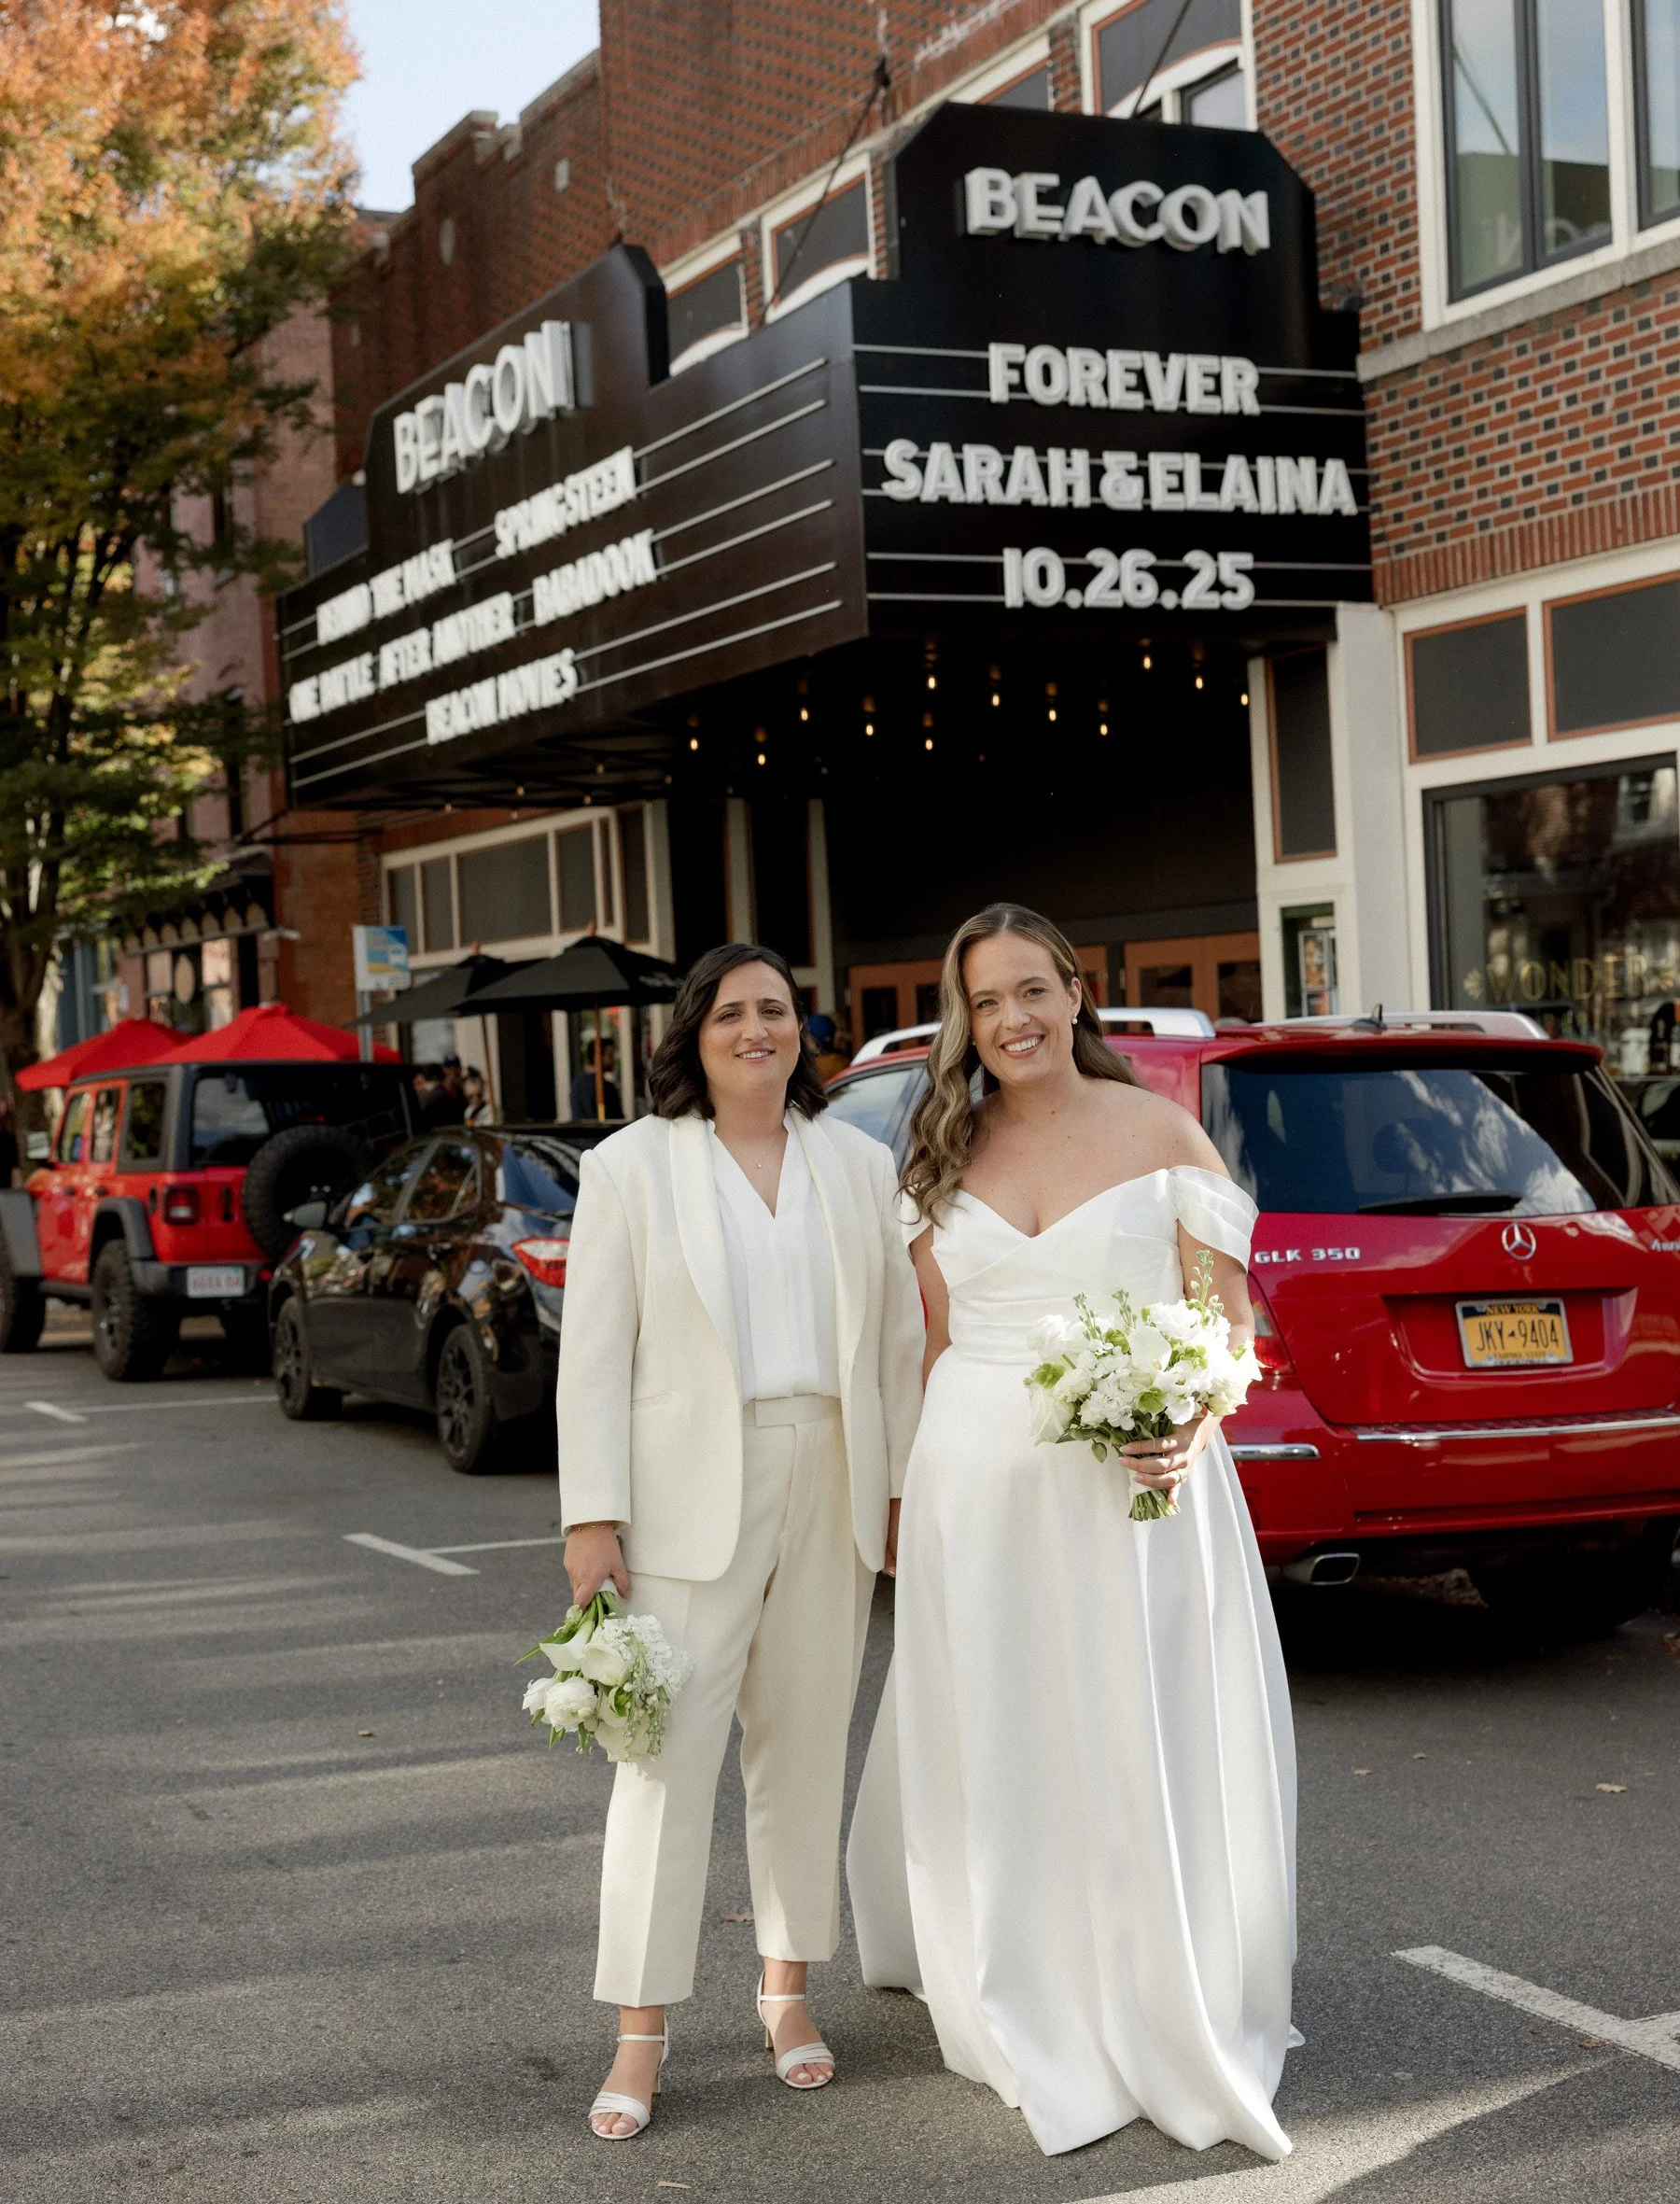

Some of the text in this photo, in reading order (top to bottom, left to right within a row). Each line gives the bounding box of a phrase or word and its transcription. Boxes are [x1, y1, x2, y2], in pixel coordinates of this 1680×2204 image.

[964, 167, 1270, 256] BEACON
[393, 319, 576, 495] BEACON
[988, 342, 1261, 415] FOREVER
[881, 438, 1358, 516] SARAH & ELAINA
[1002, 546, 1256, 611] 10.26.25
[1254, 1246, 1361, 1264] GLK 350
